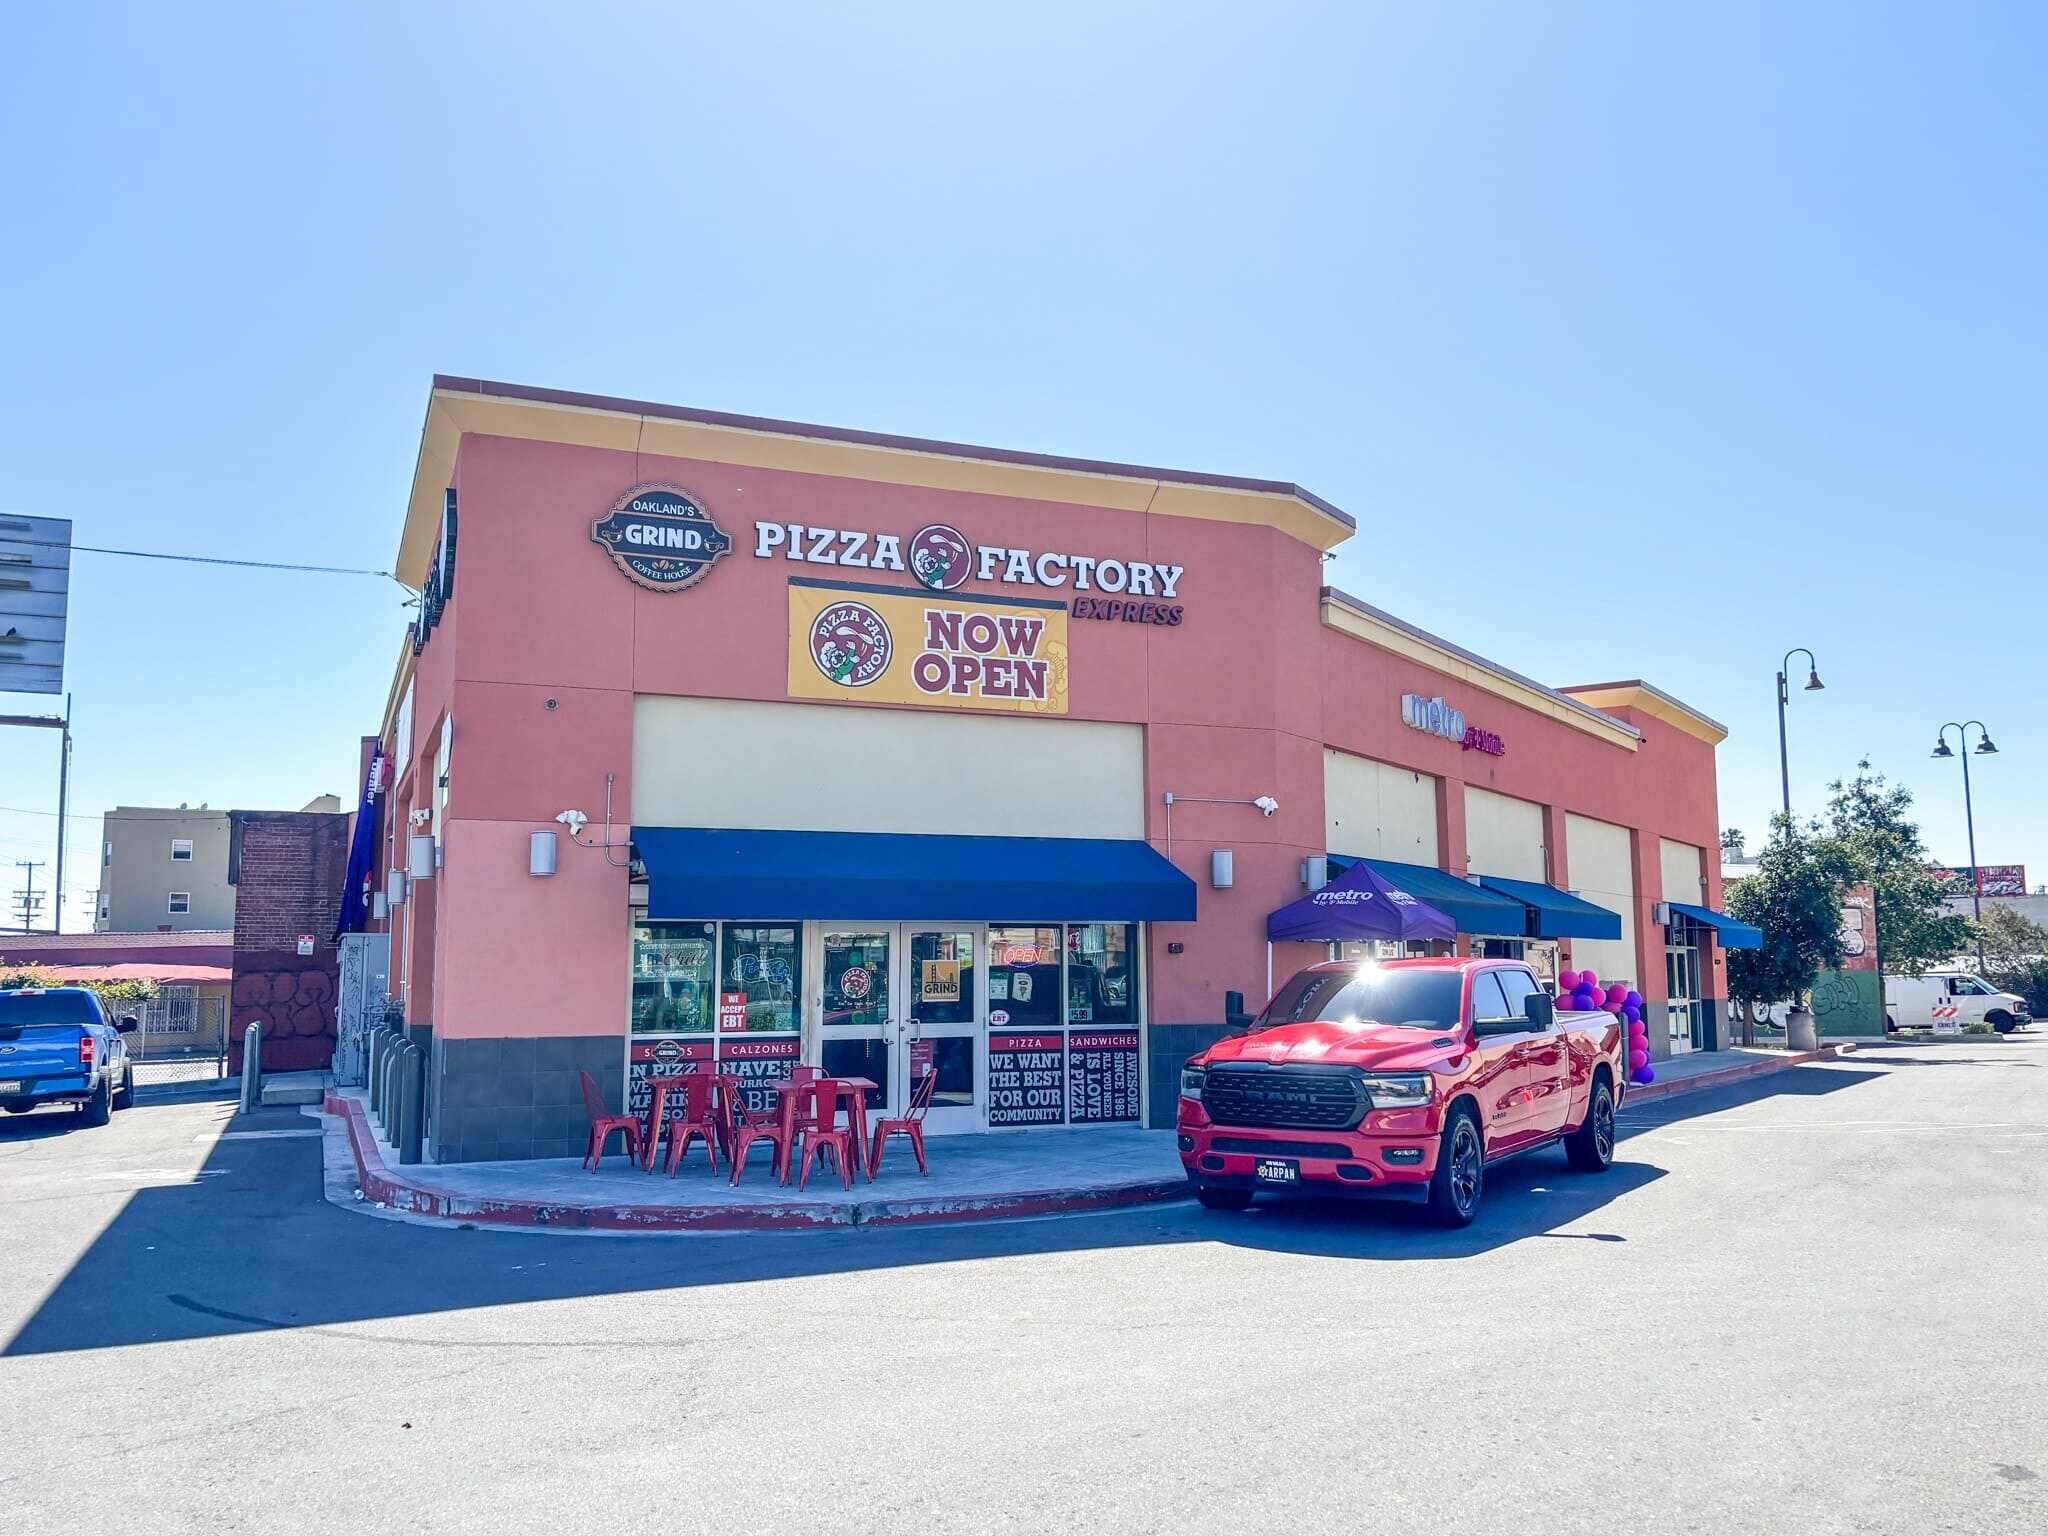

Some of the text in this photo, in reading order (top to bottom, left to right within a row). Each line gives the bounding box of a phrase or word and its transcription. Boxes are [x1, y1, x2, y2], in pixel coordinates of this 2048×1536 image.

[632, 500, 695, 517] OAKLAND'S
[625, 524, 702, 550] GRIND
[755, 521, 1184, 598] PIZZA FACTORY
[632, 560, 693, 580] COFFEE HOUSE
[1072, 597, 1184, 626] EXPRESS
[924, 608, 1046, 658] NOW
[818, 609, 886, 679] PIZZA FACTORY
[911, 650, 1050, 700] OPEN
[1402, 693, 1466, 742] metro
[1313, 889, 1373, 904] metro
[1003, 948, 1043, 963] OPEN
[924, 984, 958, 994] GRIND
[728, 995, 739, 1003] WE
[720, 1005, 746, 1013] ACCEPT
[722, 1015, 744, 1028] EBT
[731, 1044, 793, 1055] CALZONES
[1009, 1039, 1042, 1048] PIZZA
[1070, 1037, 1138, 1047] SANDWICHES
[652, 1062, 697, 1076] PIZZ
[721, 1060, 780, 1076] HAVE
[989, 1053, 1061, 1069] WE WANT
[989, 1071, 1061, 1087] THE BEST
[1071, 1053, 1085, 1119] & PIZZA
[1087, 1052, 1101, 1118] IS LOVE
[1103, 1052, 1112, 1117] ALL YOU NEED
[1114, 1052, 1125, 1117] SINCE 1985
[1127, 1052, 1138, 1117] AWESOME
[989, 1089, 1061, 1107] FOR OUR
[989, 1108, 1062, 1122] COMMUNITY
